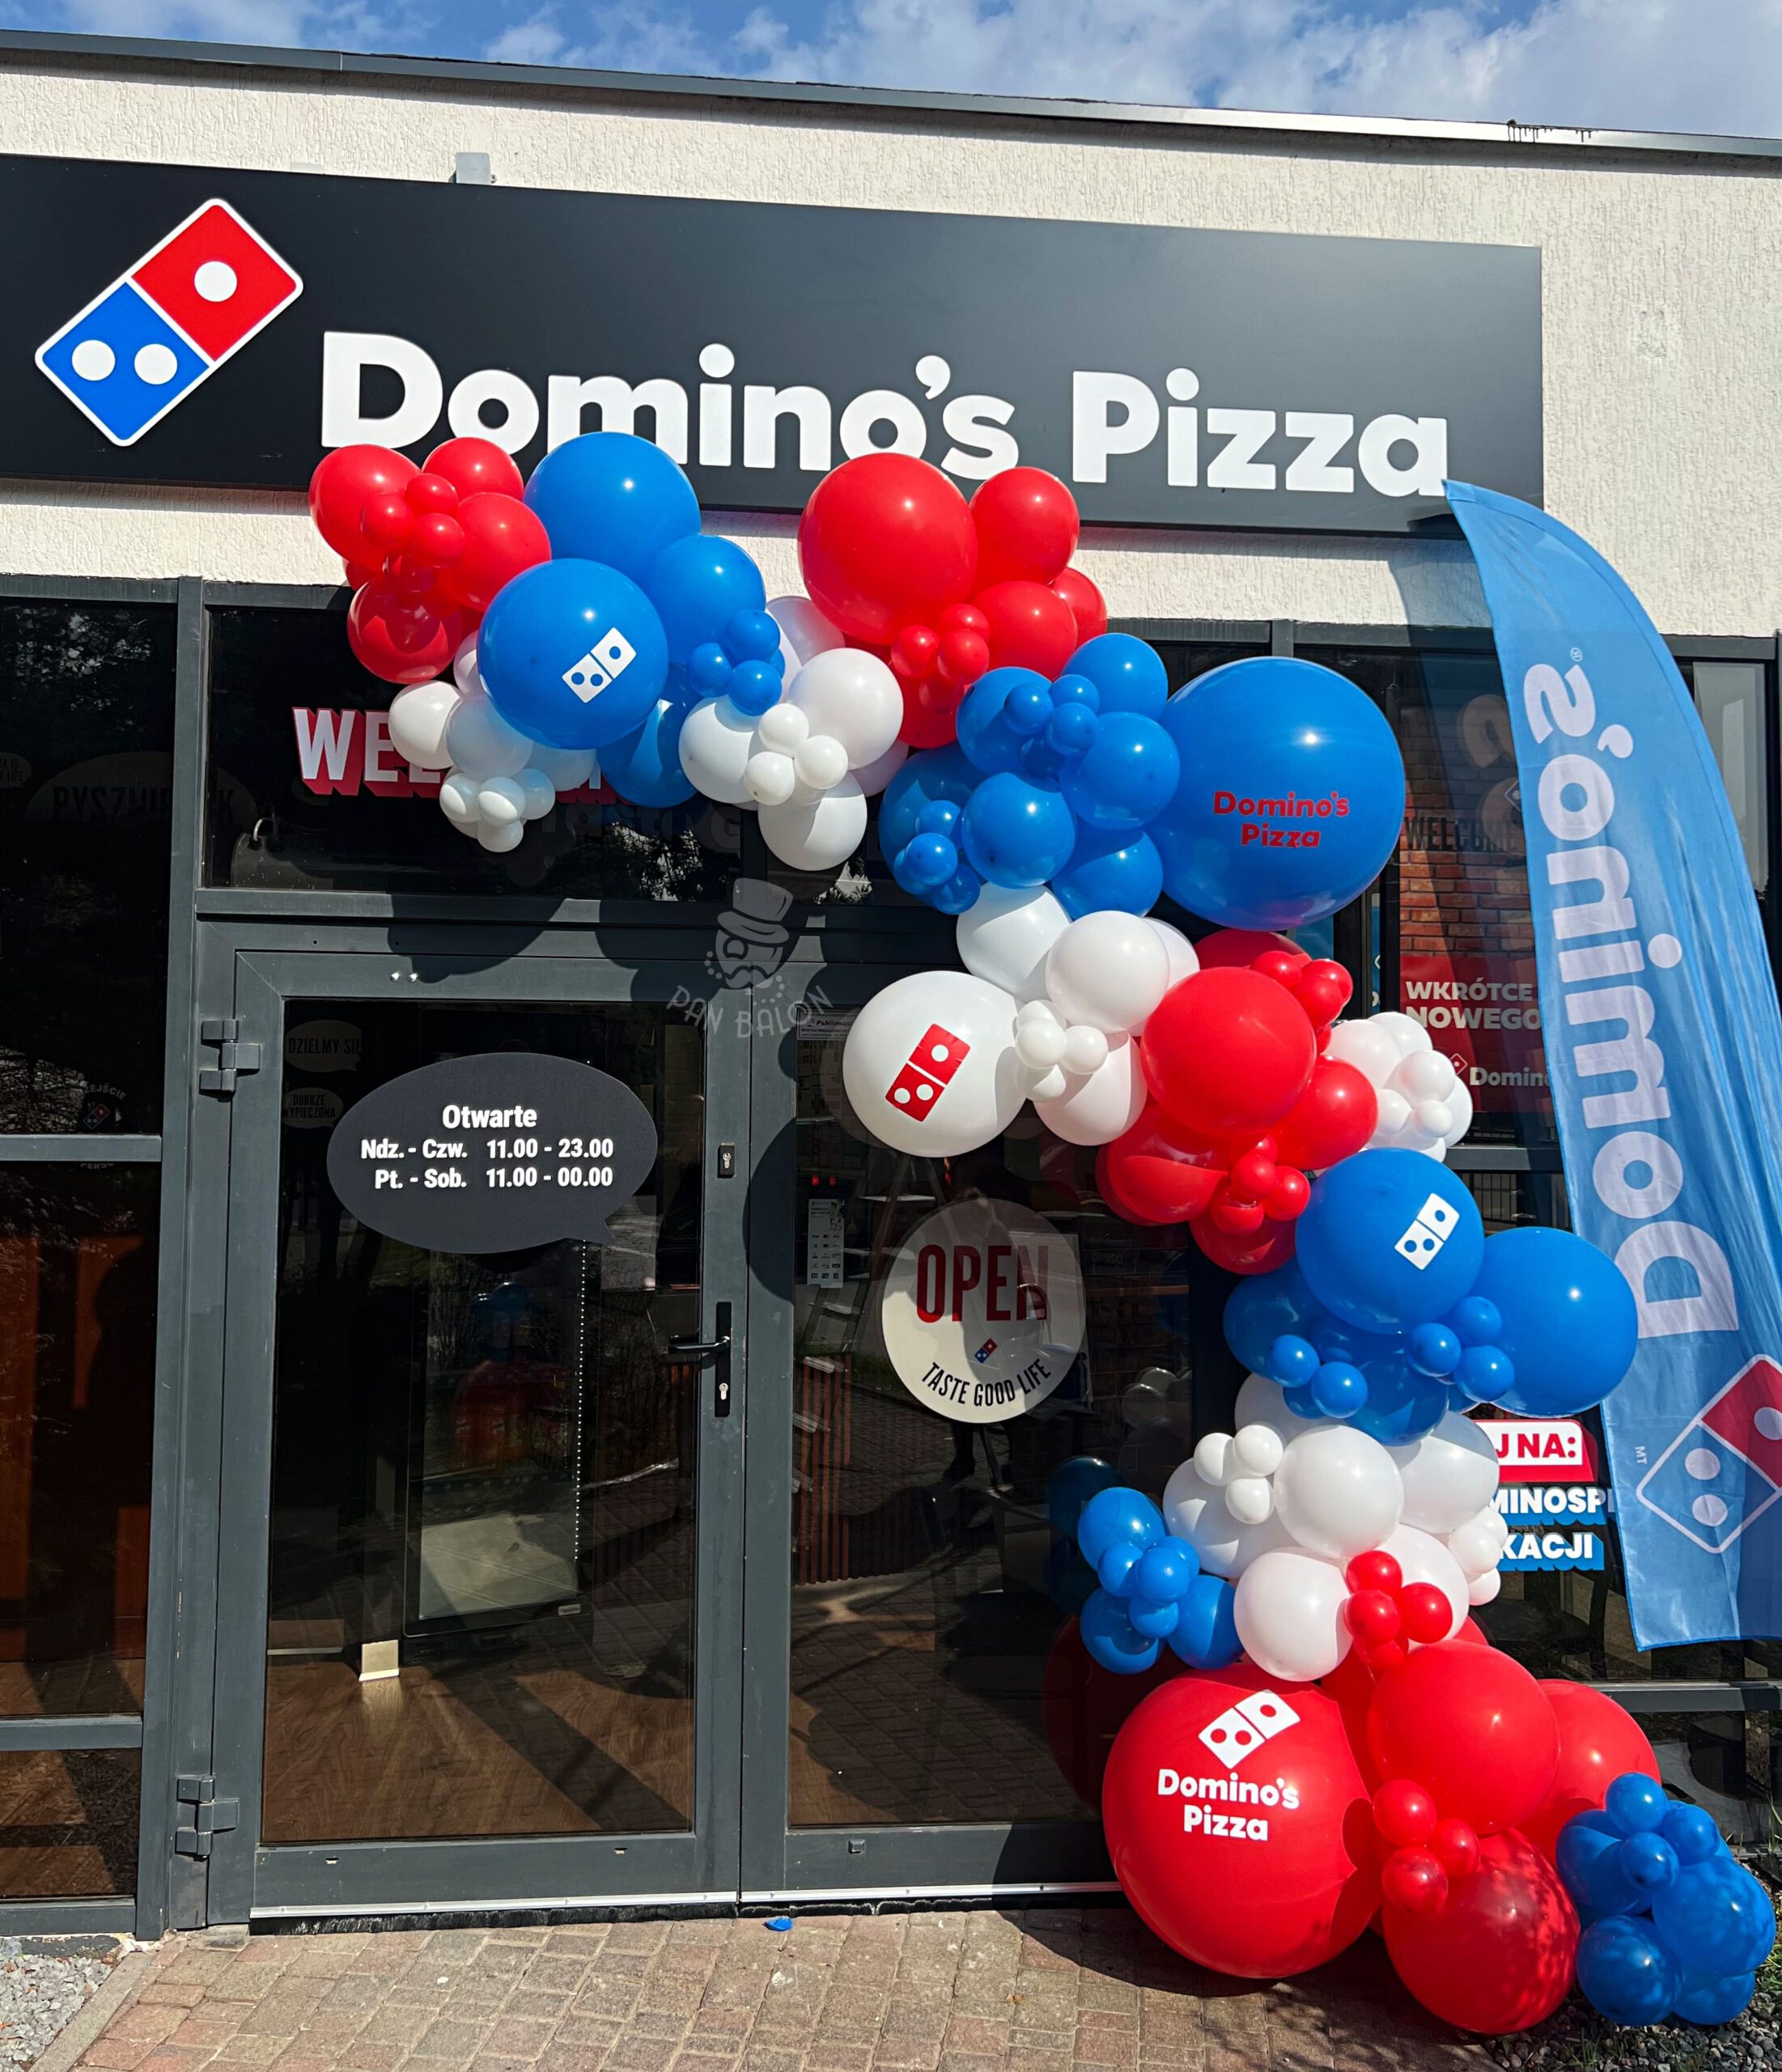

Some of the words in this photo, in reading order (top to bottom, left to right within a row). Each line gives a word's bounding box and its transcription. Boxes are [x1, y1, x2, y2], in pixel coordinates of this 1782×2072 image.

[322, 331, 1019, 480] Domino's
[1073, 367, 1448, 497] Pizza
[1213, 790, 1351, 818] Domino's
[1241, 822, 1321, 849] Pizza
[1405, 977, 1534, 1002] WKRÓTCE
[1405, 1006, 1542, 1030] NOWEGO
[289, 1037, 339, 1054] DZIELMY
[294, 1094, 325, 1106] DOBRZE
[442, 1105, 537, 1129] Otwarte
[361, 1139, 405, 1160] Ndz.
[422, 1139, 468, 1159] Czw.
[486, 1139, 538, 1159] 11.00
[558, 1138, 613, 1158] 23.00
[375, 1169, 403, 1190] Pt.
[423, 1168, 467, 1188] Sob.
[486, 1167, 538, 1188] 11.00
[557, 1166, 613, 1187] 00.00
[916, 1244, 1049, 1324] OPEN
[922, 1361, 971, 1405] TASTE
[974, 1379, 1016, 1408] GOOD
[1016, 1358, 1052, 1395] LIFE
[1517, 1433, 1577, 1459] NA:
[1157, 1768, 1300, 1810] Domino's
[1183, 1804, 1269, 1841] Pizza
